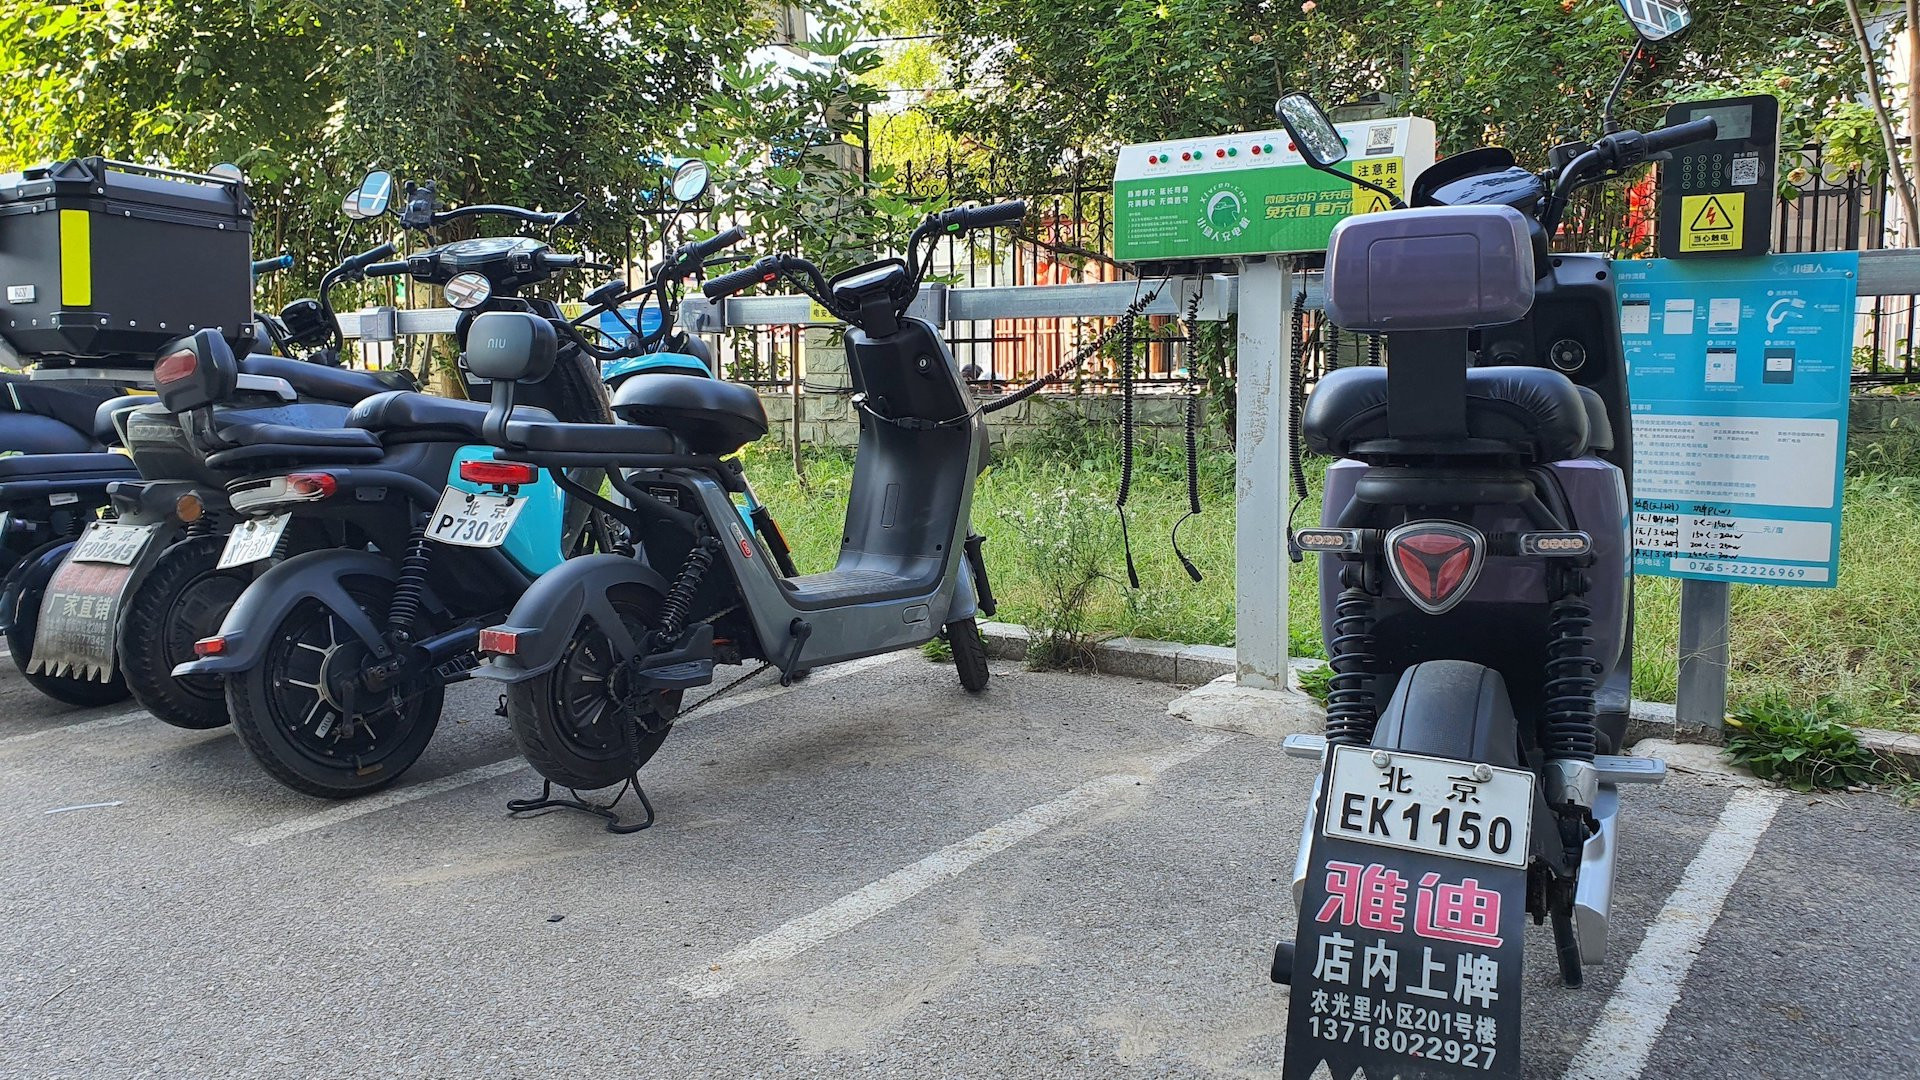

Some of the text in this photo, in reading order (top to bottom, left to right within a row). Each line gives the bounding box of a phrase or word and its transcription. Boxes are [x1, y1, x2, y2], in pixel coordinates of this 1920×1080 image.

[1358, 162, 1397, 177] 注意用
[1265, 192, 1317, 205] 微信支付分
[1265, 203, 1311, 219] 免充值
[1694, 233, 1729, 243] 当心触电
[463, 501, 507, 520] 北京
[435, 514, 509, 544] P73018
[47, 593, 113, 621] 厂家直销
[1379, 766, 1482, 804] 北京
[1340, 792, 1512, 855] EK1150
[1315, 861, 1504, 948] 雅迪
[1312, 931, 1499, 1009] 店内上牌
[1310, 988, 1497, 1046] 农光里小区201号楼
[1308, 1016, 1497, 1071] 13718022927
